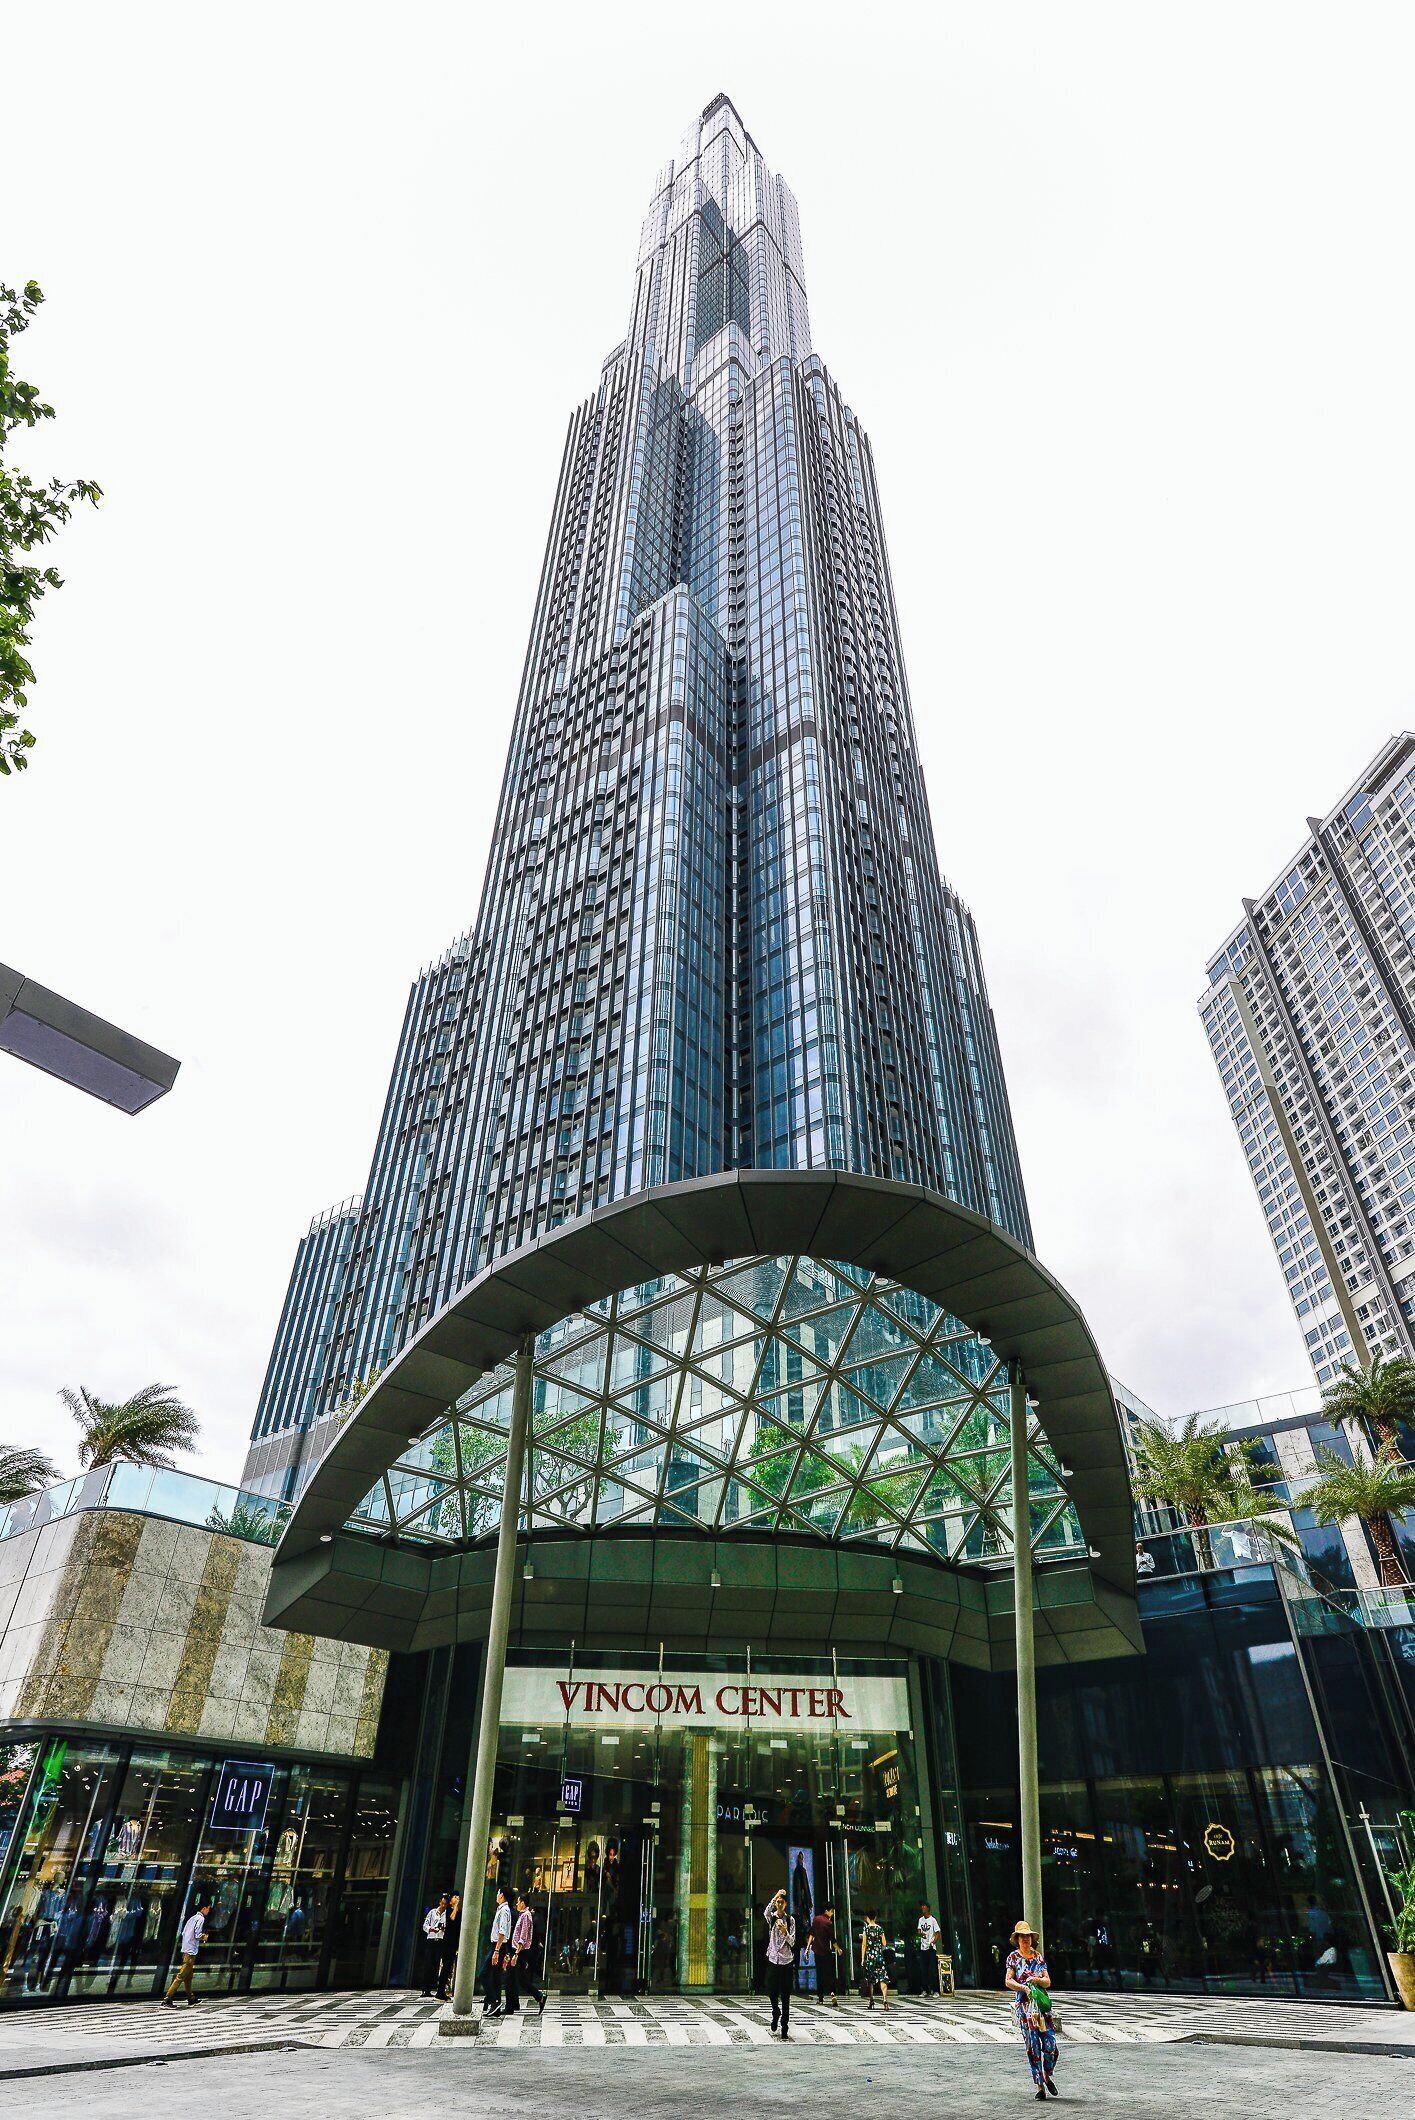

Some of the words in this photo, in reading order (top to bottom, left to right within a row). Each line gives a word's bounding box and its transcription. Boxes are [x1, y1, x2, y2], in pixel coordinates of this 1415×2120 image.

[556, 1681, 705, 1714] VINCOM
[716, 1685, 852, 1717] CENTER
[224, 1778, 262, 1812] GAP
[565, 1785, 579, 1800] GAP
